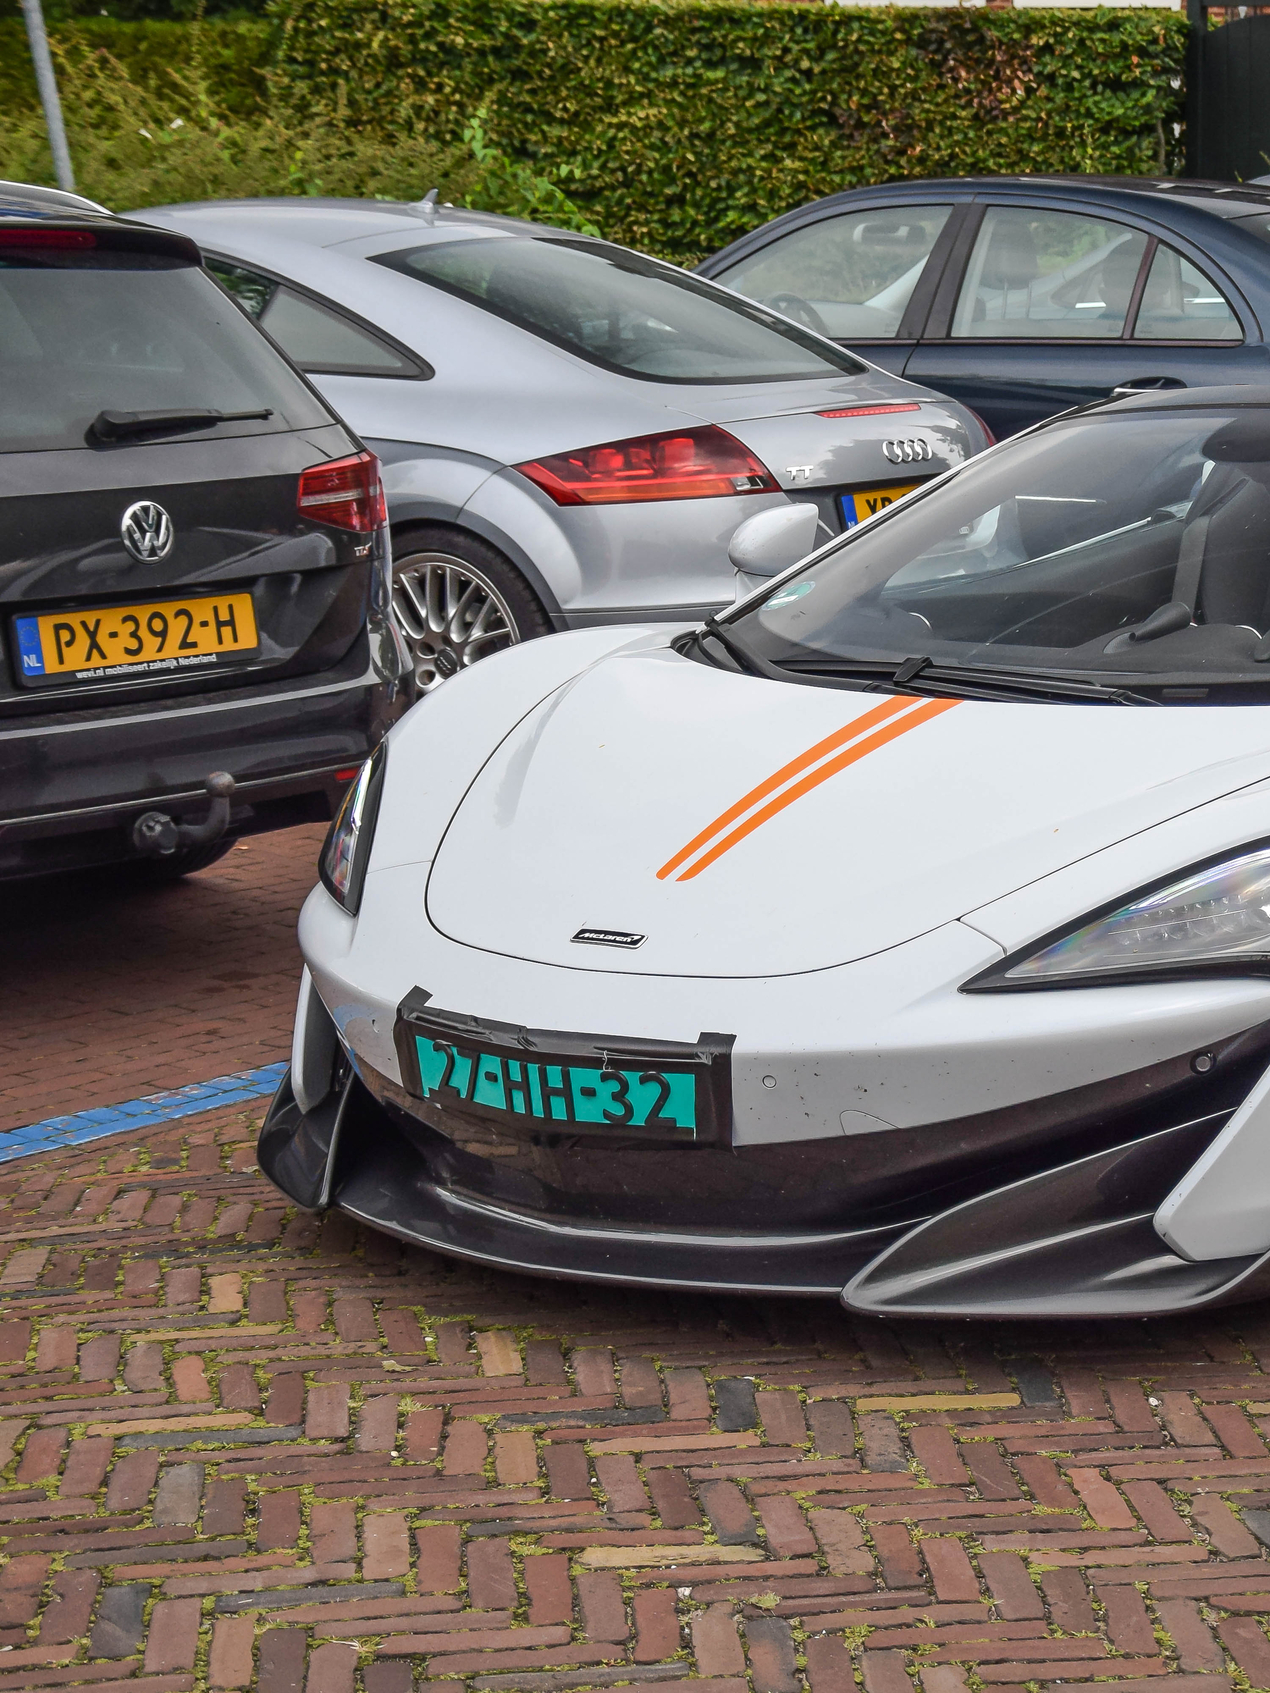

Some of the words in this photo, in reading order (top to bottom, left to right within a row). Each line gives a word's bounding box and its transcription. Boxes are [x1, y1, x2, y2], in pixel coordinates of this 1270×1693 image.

[786, 465, 814, 481] TT
[52, 603, 239, 666] PX-392-H
[23, 653, 42, 669] NL
[75, 667, 105, 679] wevi.nl
[105, 661, 148, 676] mobiliseert
[149, 658, 179, 670] zakelijk
[178, 653, 217, 666] Nederland
[578, 932, 633, 943] McLaren
[432, 1039, 677, 1127] 27-HH-32
